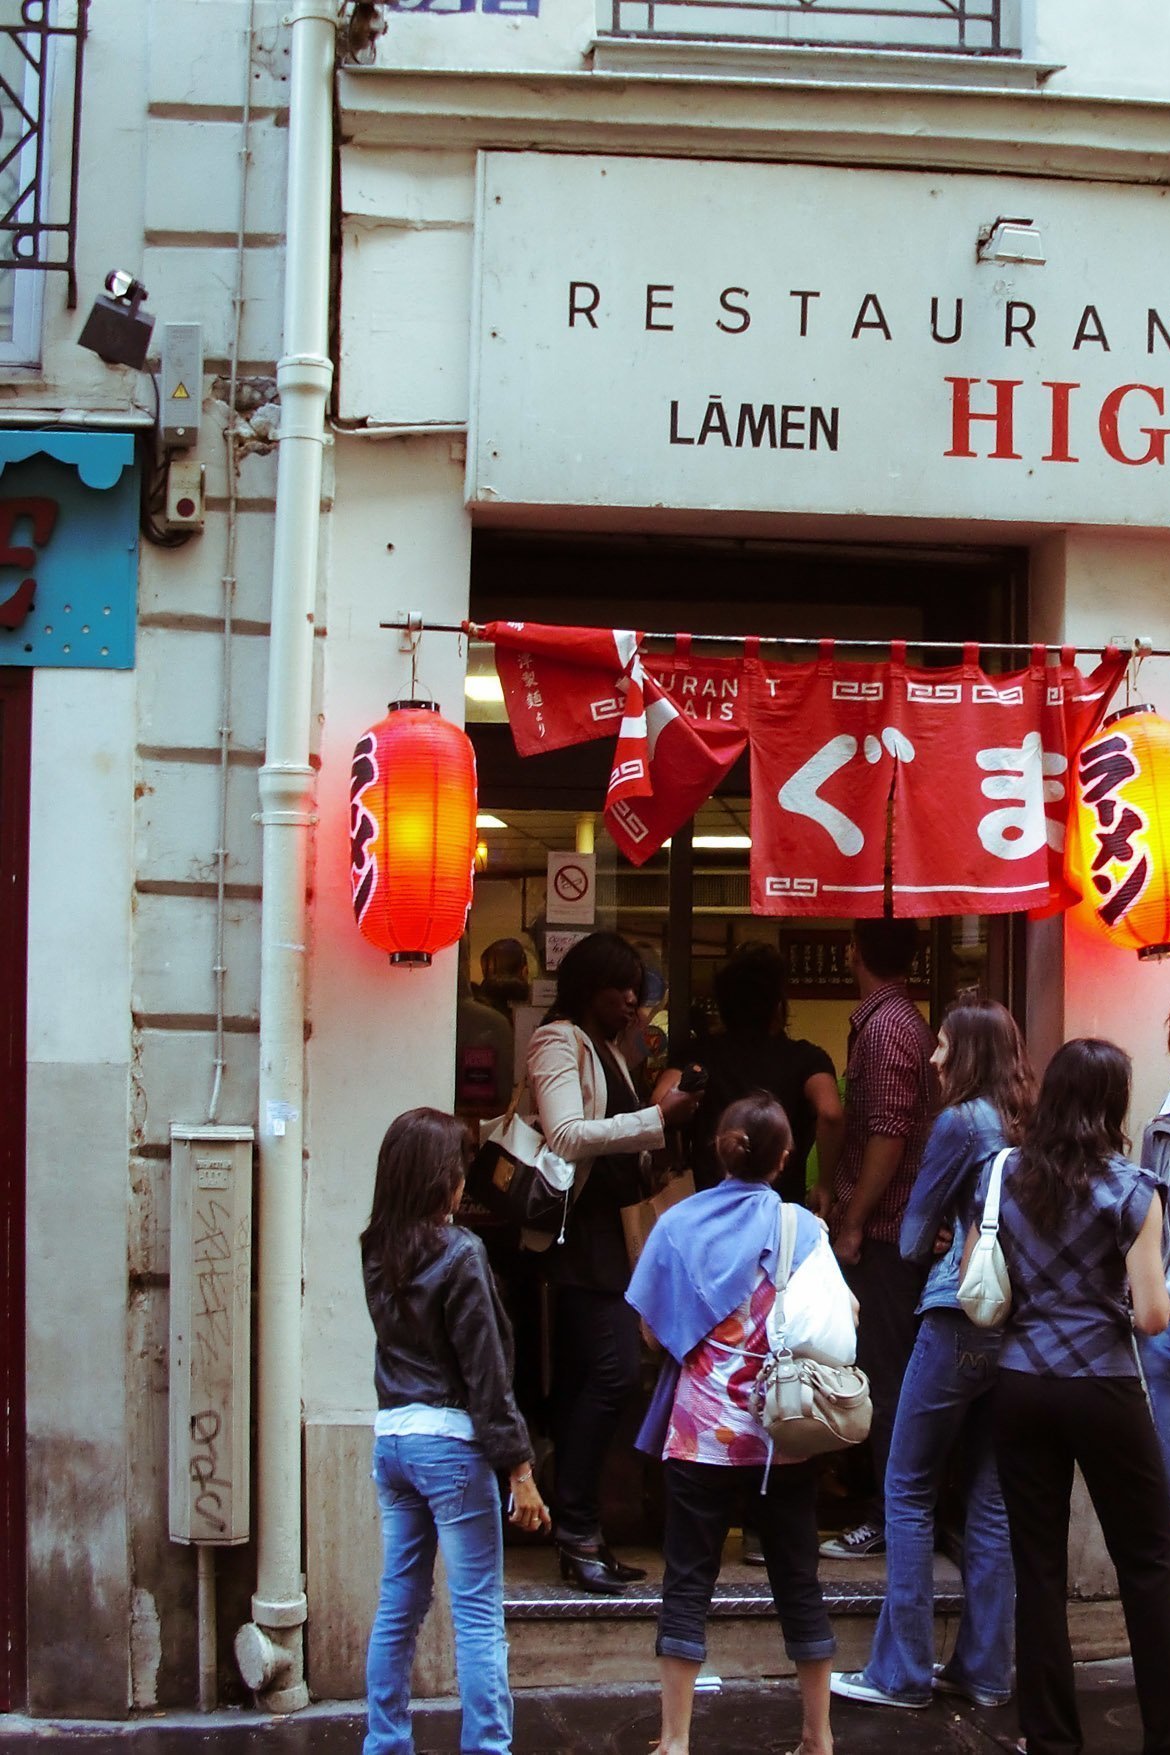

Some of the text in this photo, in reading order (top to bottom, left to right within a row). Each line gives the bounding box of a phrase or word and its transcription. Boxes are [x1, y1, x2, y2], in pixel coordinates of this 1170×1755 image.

[658, 672, 780, 698] URANT
[682, 699, 734, 721] AIS
[778, 726, 1067, 860] ぐま
[1078, 732, 1153, 928] ラーメン
